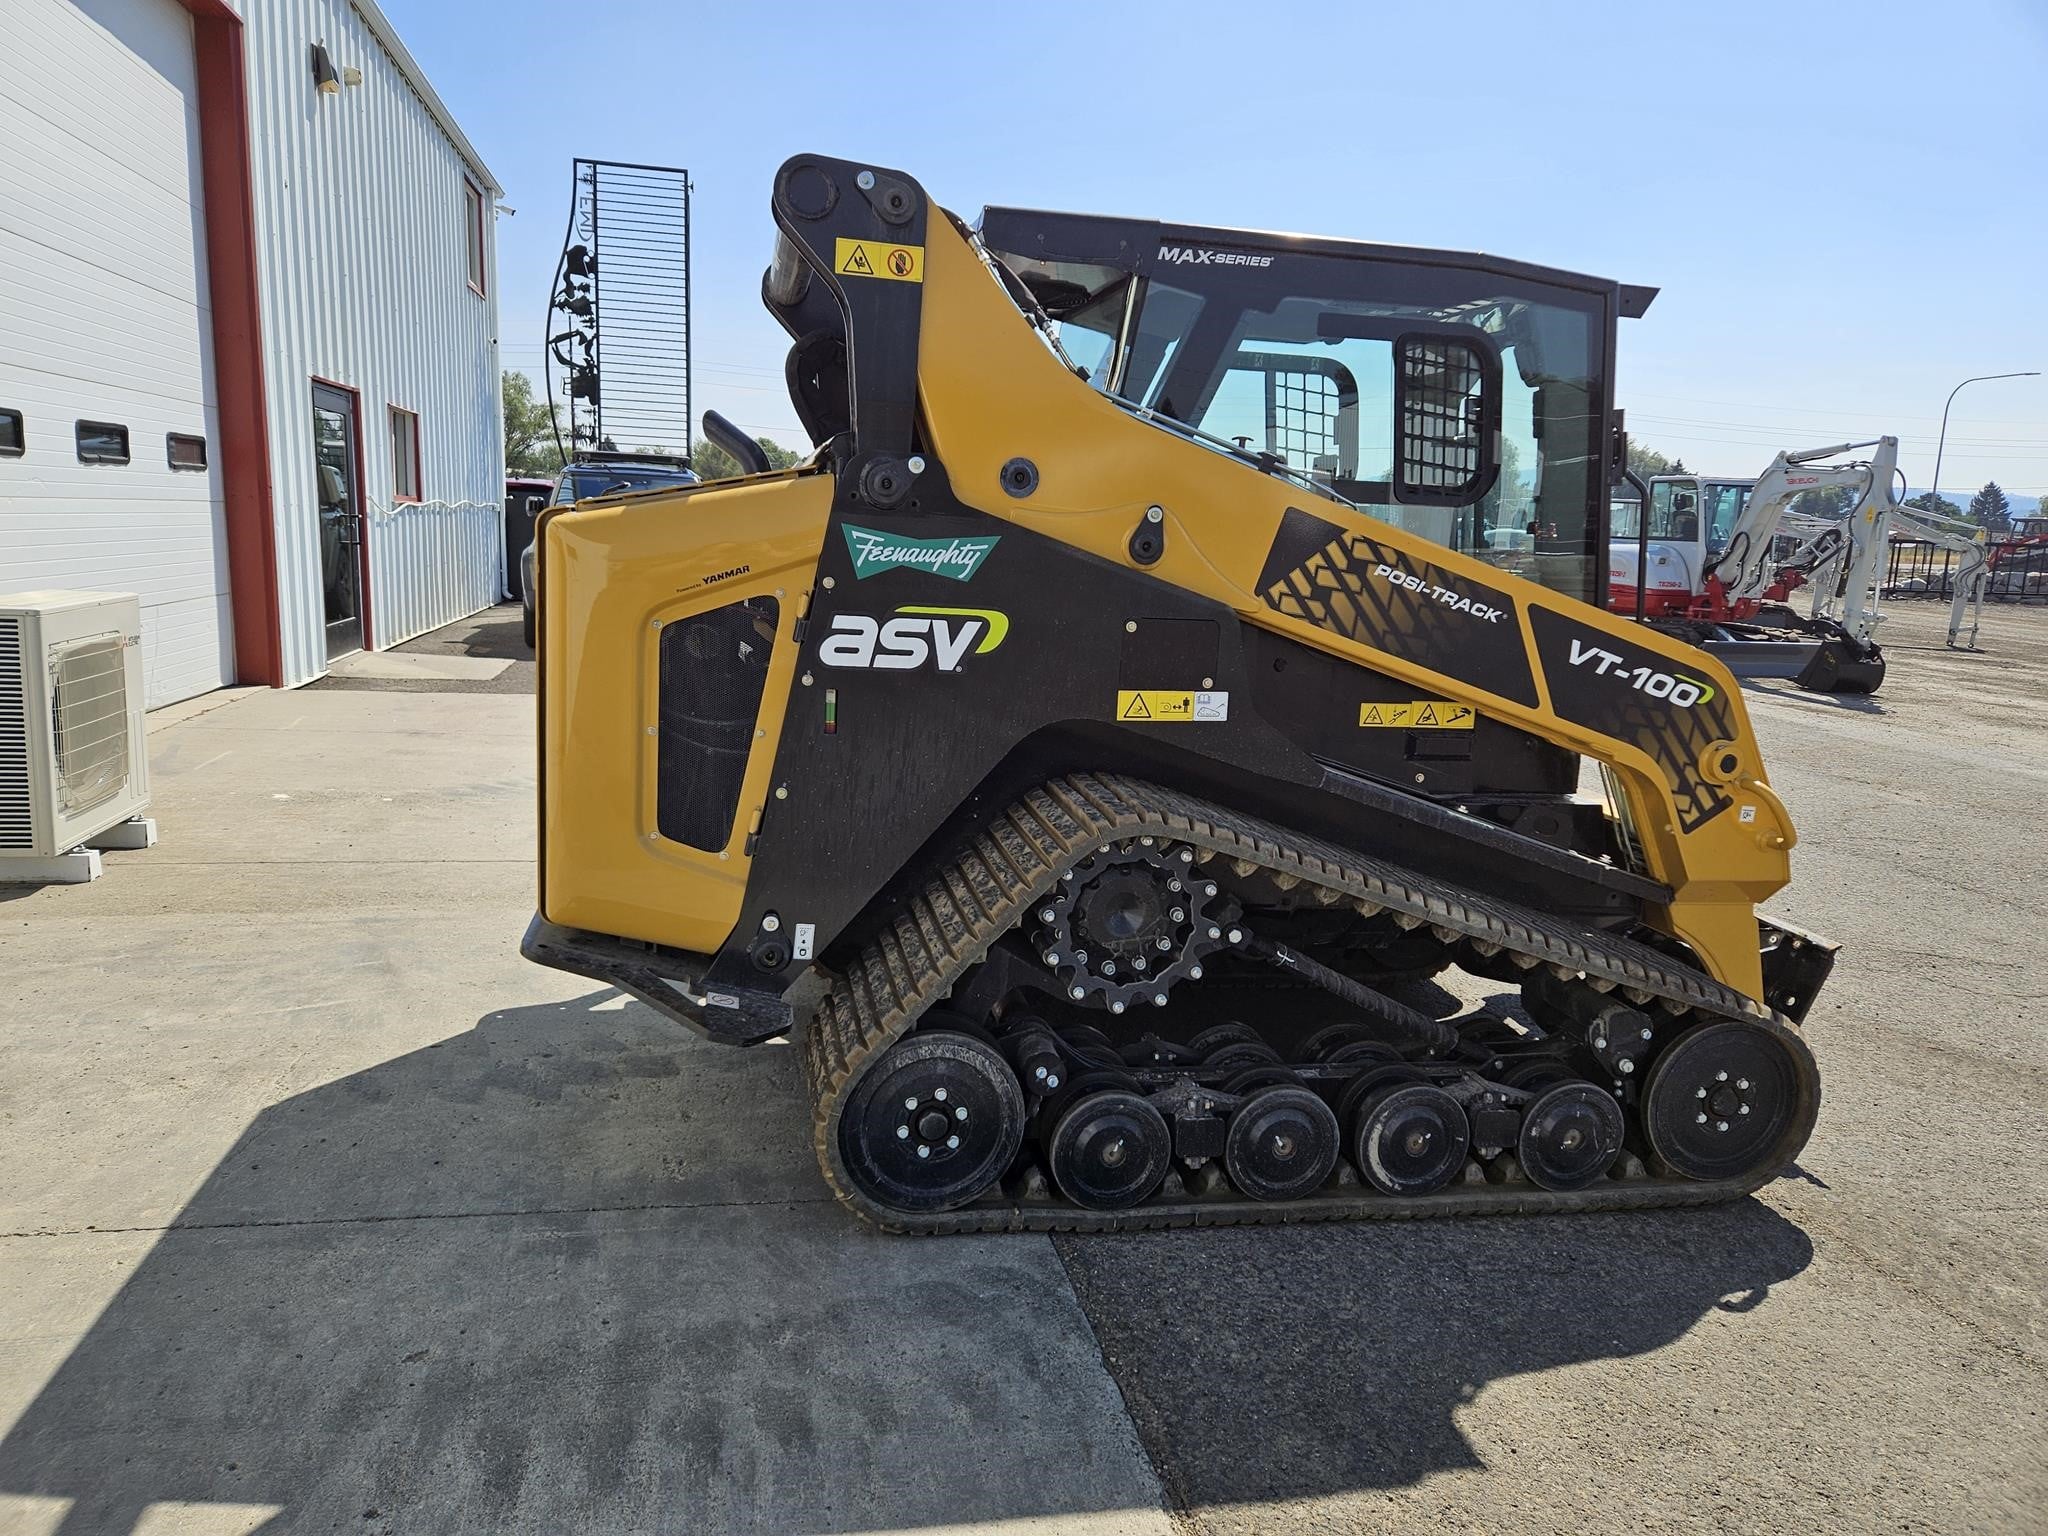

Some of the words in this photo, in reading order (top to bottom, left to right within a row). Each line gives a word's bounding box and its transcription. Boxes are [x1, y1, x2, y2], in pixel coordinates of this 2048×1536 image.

[1158, 246, 1272, 267] MAX-SERIES
[702, 565, 750, 584] YANMAR
[851, 530, 989, 579] Feenaughty
[1373, 564, 1504, 624] POSI-TRACK
[1569, 639, 1701, 708] VT-100
